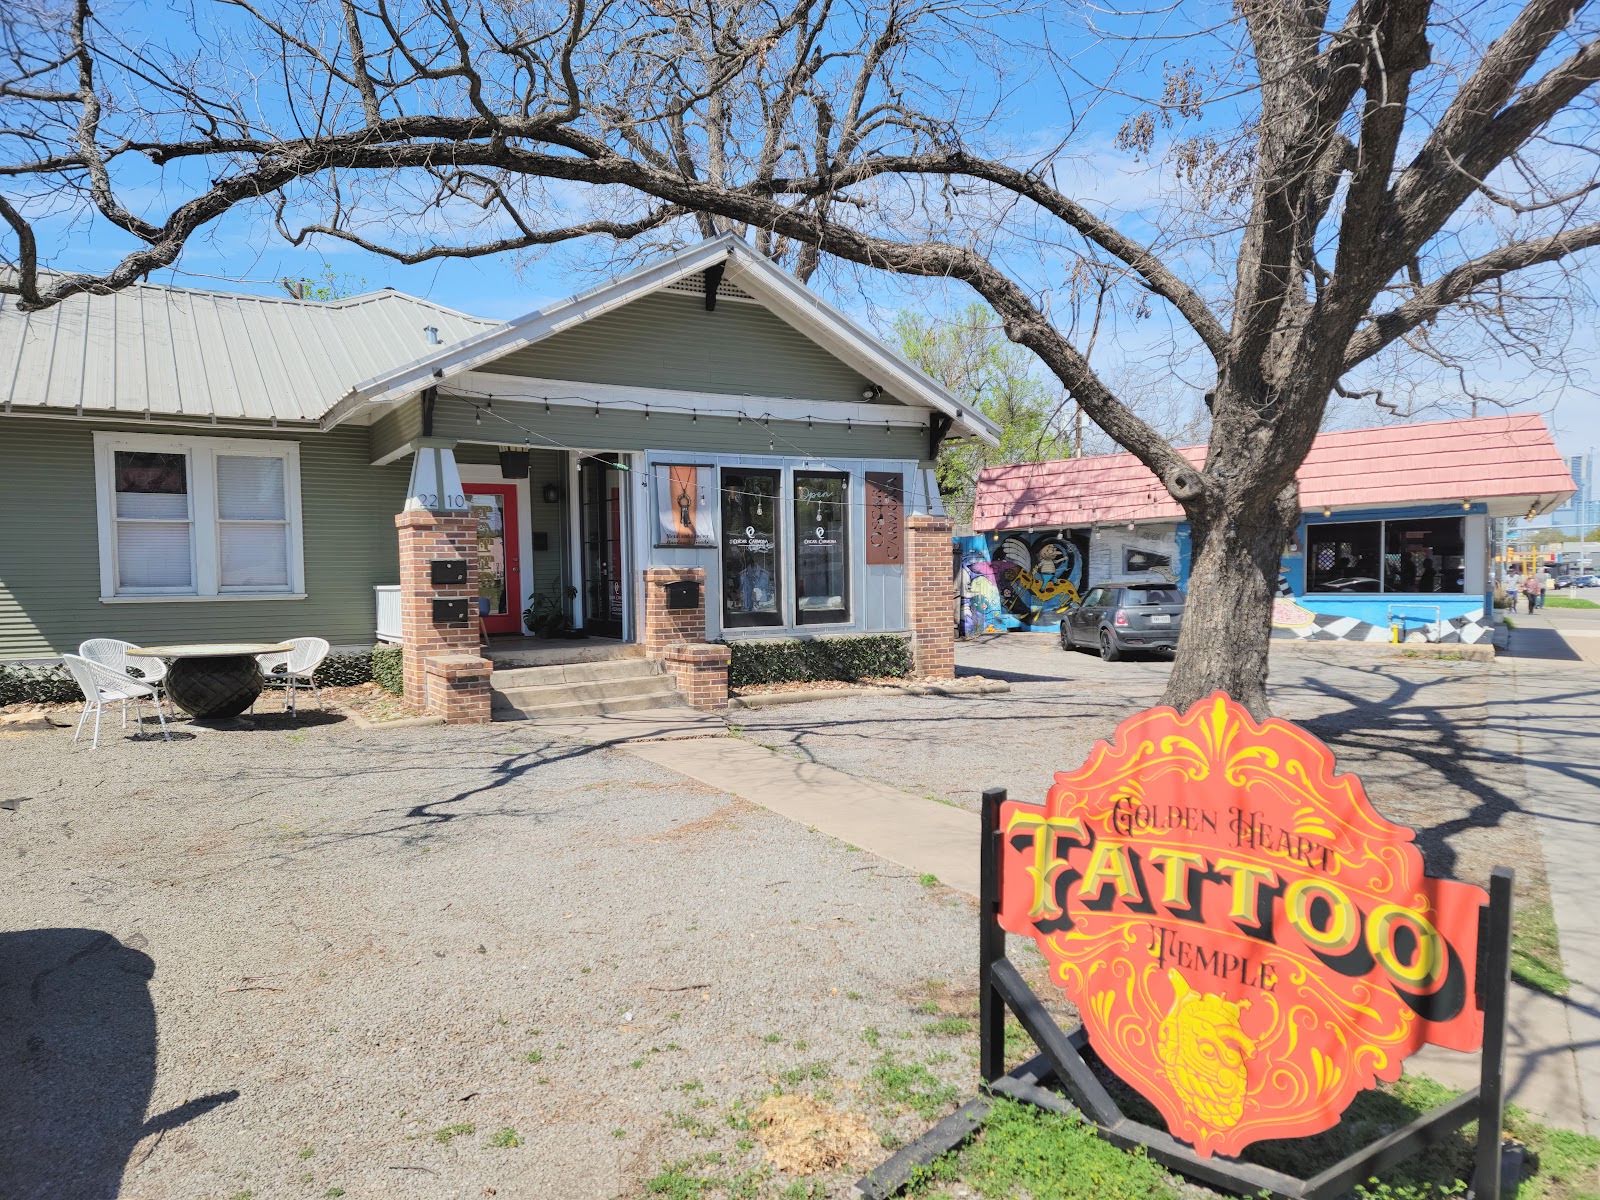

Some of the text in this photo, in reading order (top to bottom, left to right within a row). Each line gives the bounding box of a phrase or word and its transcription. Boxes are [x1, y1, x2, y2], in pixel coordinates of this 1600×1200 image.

[870, 488, 884, 548] OSCAR
[886, 476, 900, 560] CARMONA
[1112, 796, 1335, 872] GOLDEN HEART
[1006, 808, 1450, 992] TATTOO
[1147, 921, 1278, 993] TEMPLE
